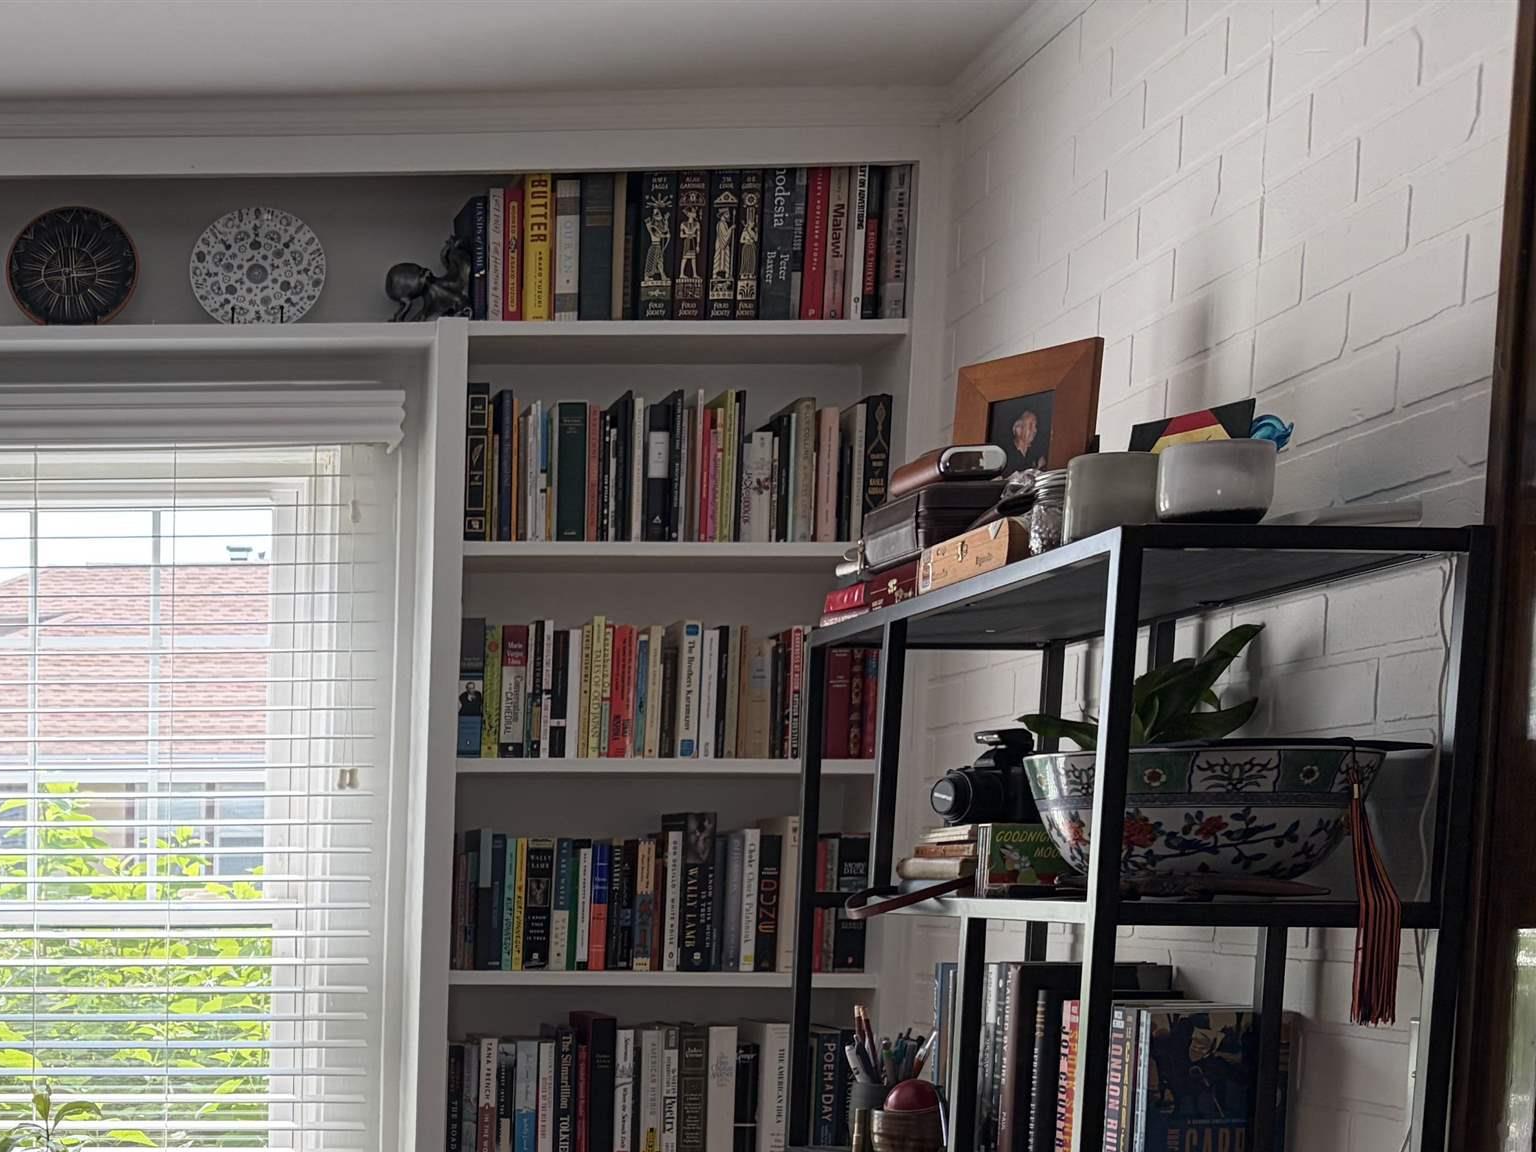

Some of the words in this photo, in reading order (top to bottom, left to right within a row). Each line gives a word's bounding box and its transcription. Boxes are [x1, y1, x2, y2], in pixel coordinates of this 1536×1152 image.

[529, 180, 548, 243] BUTTER
[830, 203, 847, 258] Malawi
[764, 251, 777, 284] Baxter
[777, 254, 790, 281] Peter
[687, 640, 696, 655] The
[685, 657, 696, 688] Brothers
[503, 692, 513, 735] CATHEDRAL
[687, 867, 700, 908] WALLY
[684, 913, 697, 948] LAMB
[1003, 971, 1013, 1031] PLAGUED
[561, 1034, 573, 1053] The
[1059, 1026, 1070, 1062] JOE
[822, 1043, 836, 1081] POEM
[1000, 1056, 1008, 1085] FIRE
[1107, 1032, 1124, 1110] LONDON
[484, 1067, 492, 1100] FRENCH
[559, 1055, 572, 1109] Silmarillion
[450, 1101, 458, 1119] THE
[820, 1094, 834, 1121] DAY
[450, 1123, 458, 1151] ROAD
